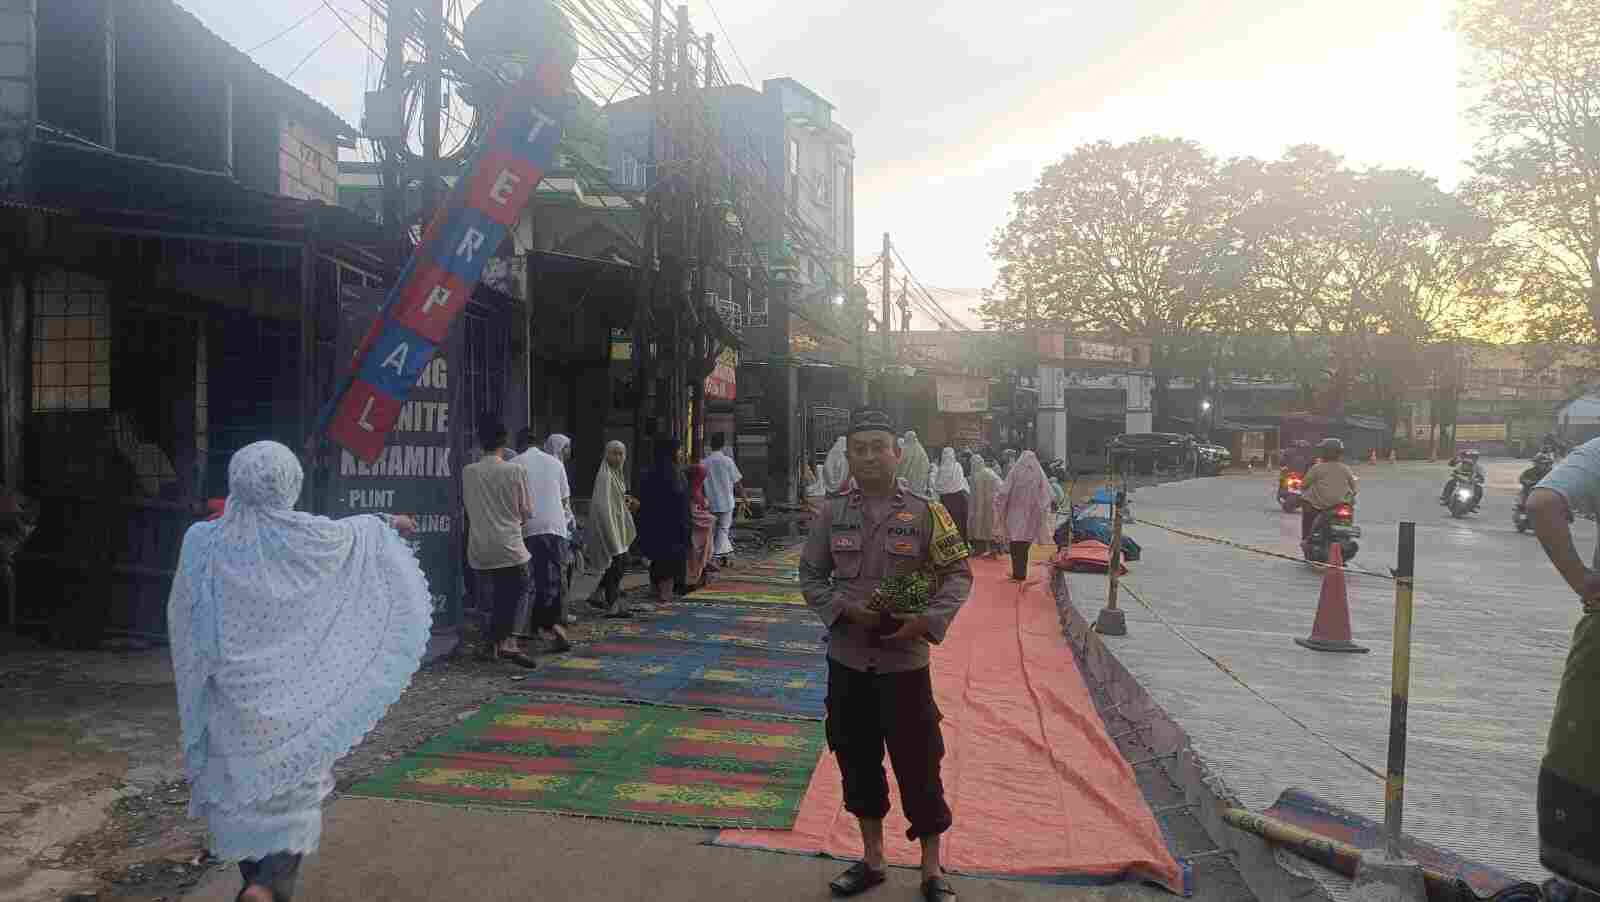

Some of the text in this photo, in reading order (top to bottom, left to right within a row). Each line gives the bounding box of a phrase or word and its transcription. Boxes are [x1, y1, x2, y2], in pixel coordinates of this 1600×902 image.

[357, 104, 556, 432] TERPAL
[398, 401, 449, 432] NITE
[348, 488, 395, 508] PLINT
